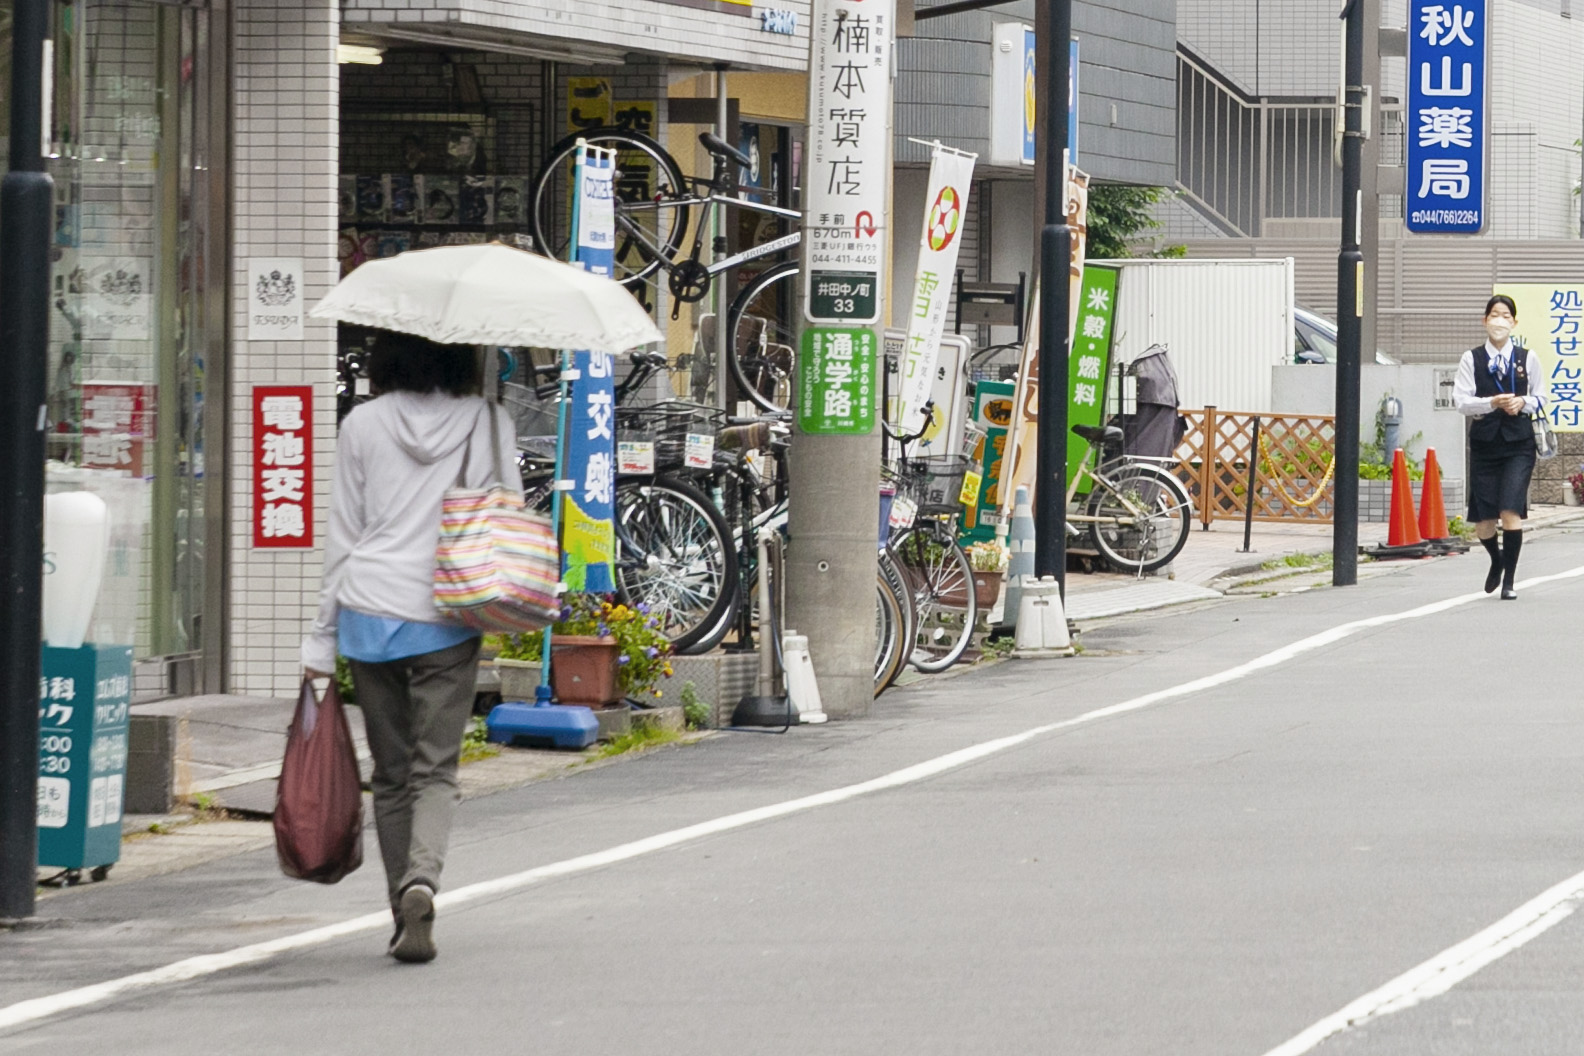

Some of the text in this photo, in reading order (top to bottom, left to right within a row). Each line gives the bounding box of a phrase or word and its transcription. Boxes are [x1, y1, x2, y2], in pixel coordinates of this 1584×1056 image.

[828, 14, 870, 196] 楠本質店
[1418, 5, 1474, 200] 秋山薬局
[812, 255, 877, 264] 044-411-4455
[813, 228, 852, 238] 670m
[819, 214, 845, 225] 手前
[818, 283, 870, 297] 井田中ノ町
[833, 299, 854, 313] 33
[824, 333, 853, 417] 通学路
[860, 334, 870, 417] 安全・安心のまち
[1074, 287, 1110, 407] 米穀・燃料
[1550, 290, 1582, 426] 処方せん受付
[260, 395, 305, 538] 電池交換
